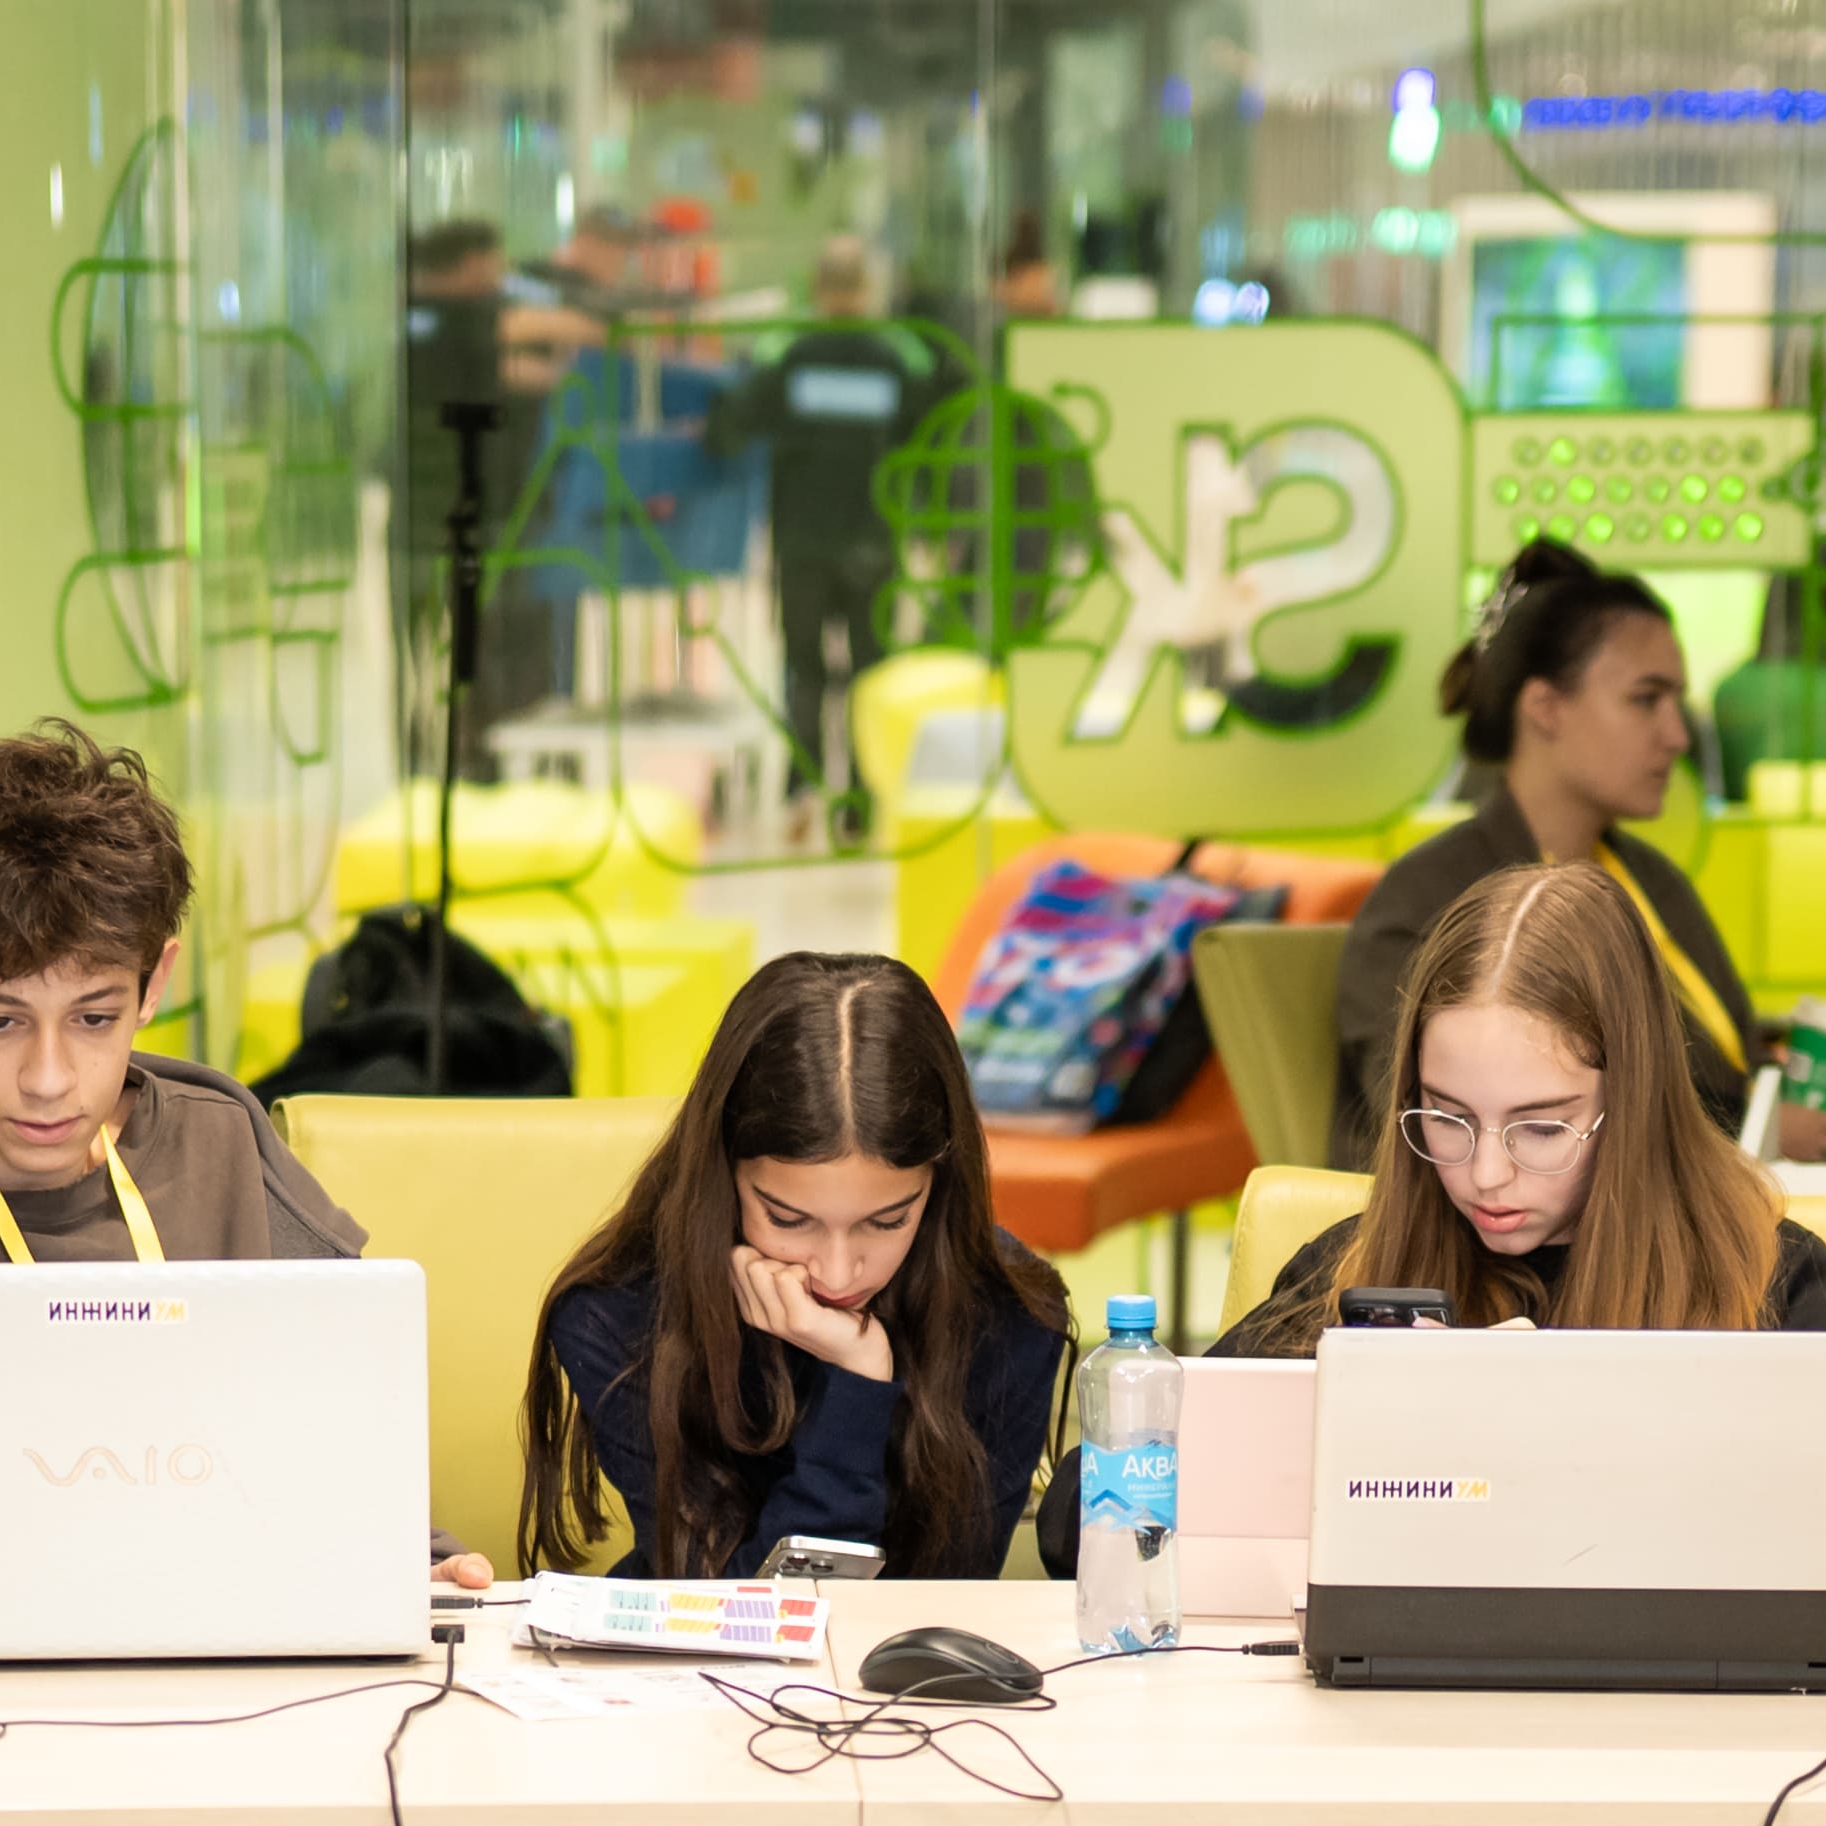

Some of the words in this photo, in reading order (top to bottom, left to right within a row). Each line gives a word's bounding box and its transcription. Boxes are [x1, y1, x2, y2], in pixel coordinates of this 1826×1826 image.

[48, 1301, 185, 1321] ИНЖИНИУМ
[22, 1444, 214, 1487] VAIO
[1348, 1480, 1487, 1498] ИНЖИНИУМ
